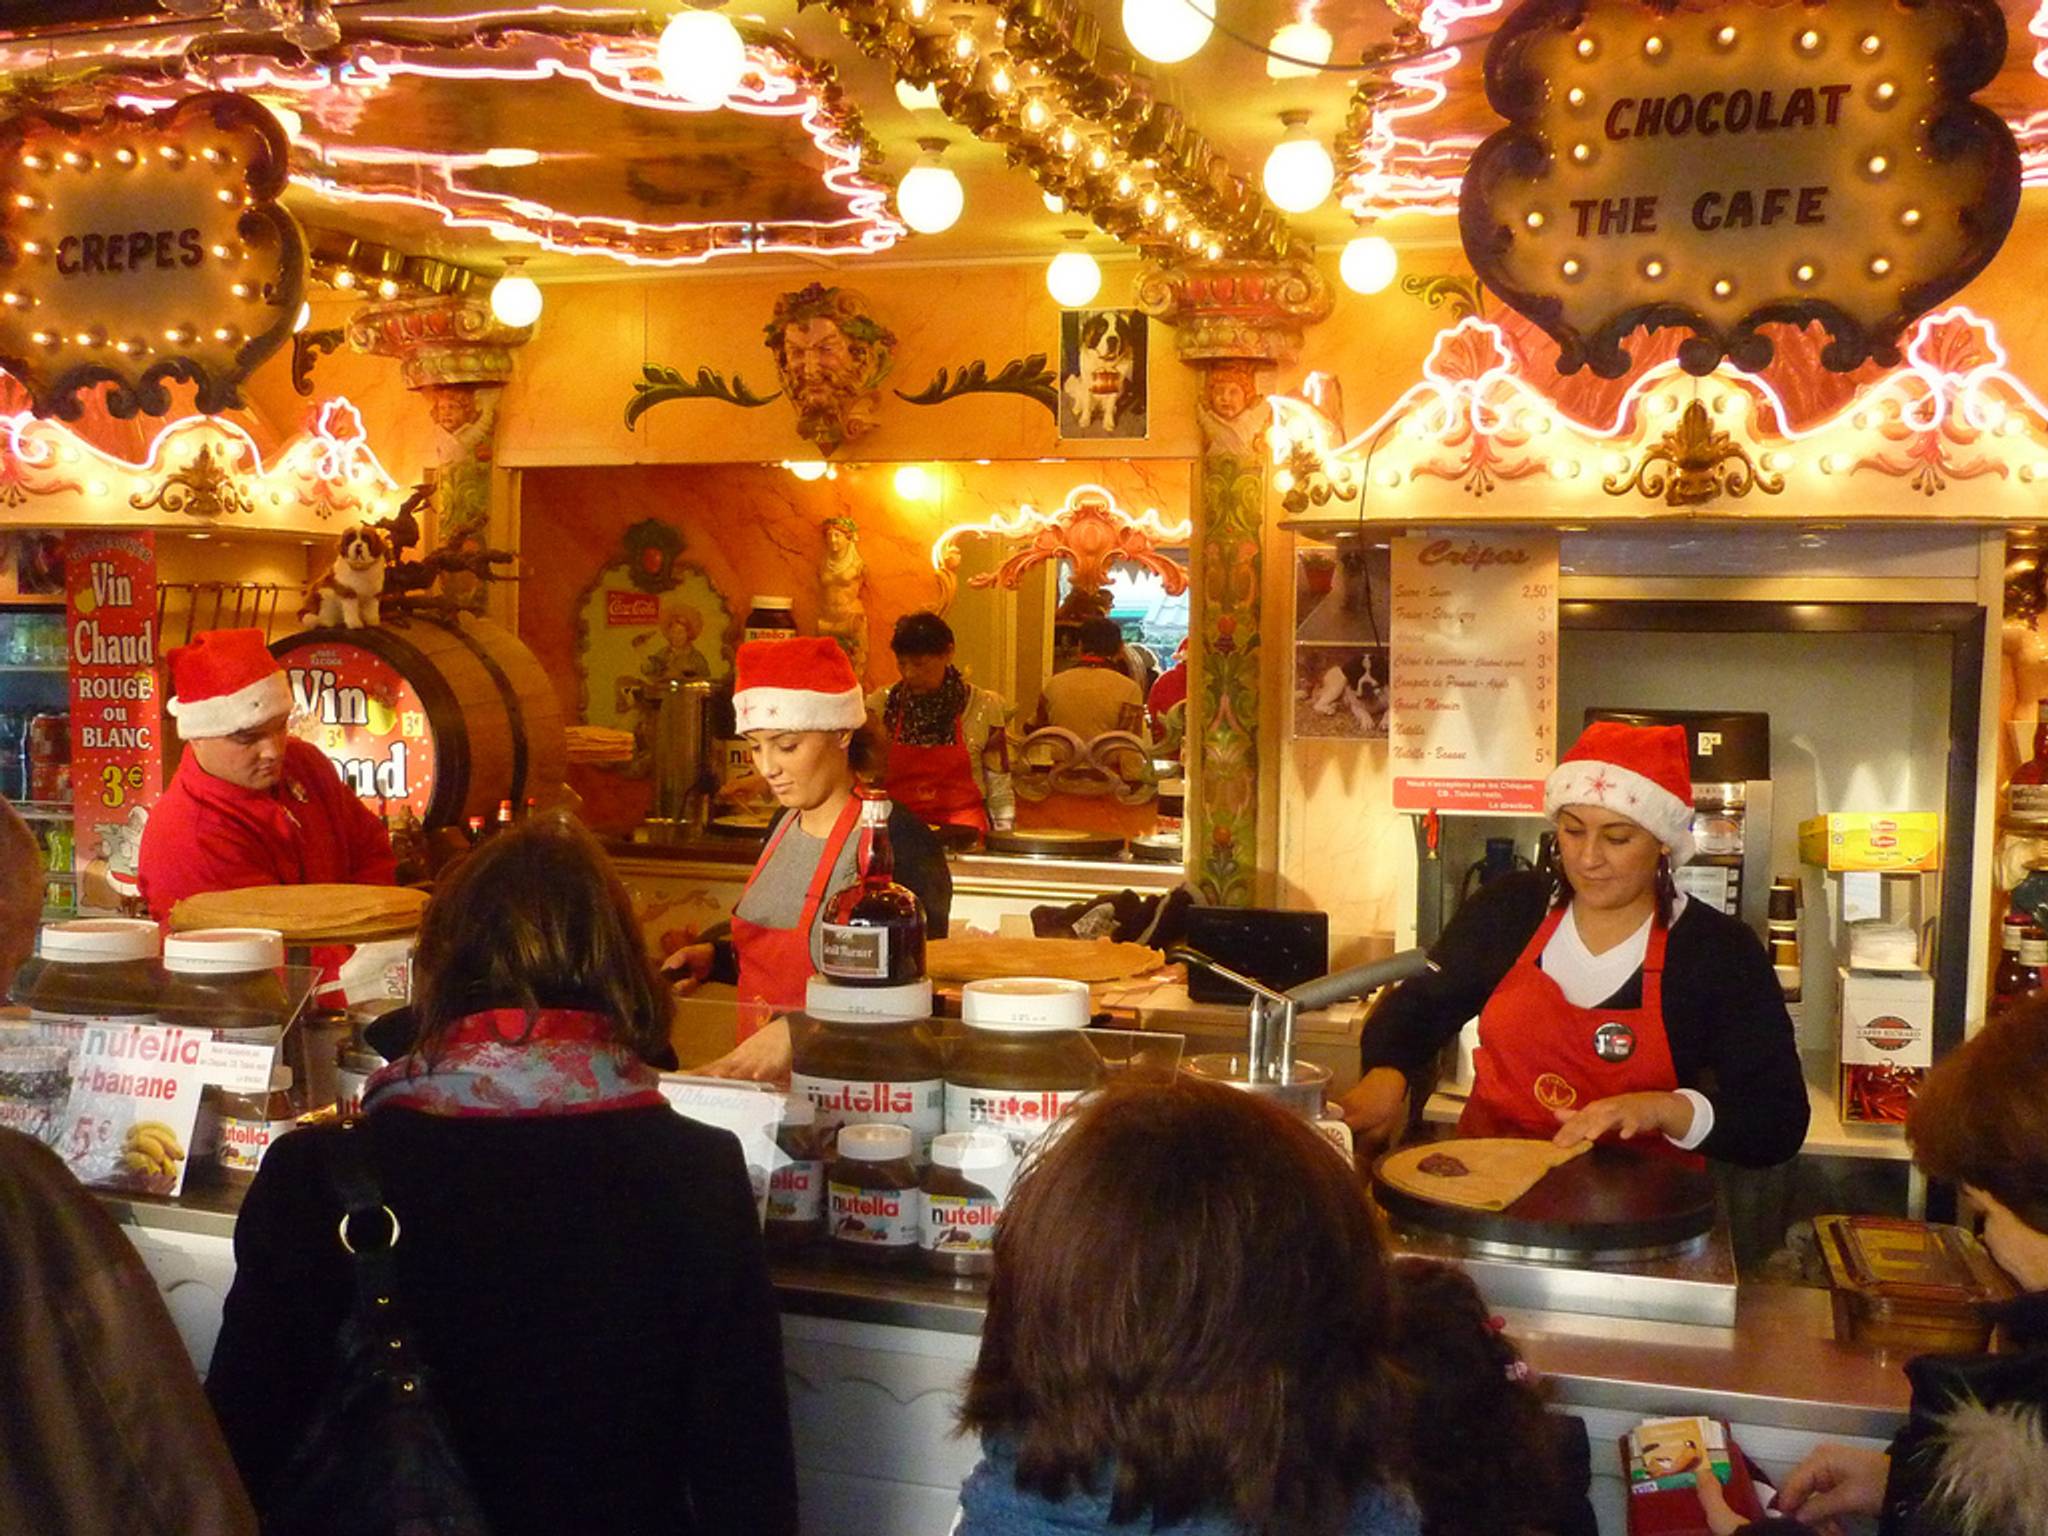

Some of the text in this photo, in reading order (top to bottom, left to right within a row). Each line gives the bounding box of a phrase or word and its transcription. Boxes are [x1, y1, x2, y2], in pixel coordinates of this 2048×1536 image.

[1604, 84, 1853, 141] CHOCOLAT
[1570, 186, 1829, 237] THE CAFE
[56, 228, 204, 275] CREPES
[91, 561, 133, 607] Vin
[73, 619, 154, 666] Chaud
[78, 677, 151, 700] ROUGE
[289, 669, 369, 724] Vin
[102, 705, 128, 722] ou
[82, 727, 151, 748] BLANC
[102, 764, 144, 808] 3€
[84, 1026, 200, 1065] nutella
[808, 1084, 913, 1113] nutella
[223, 1126, 270, 1146] utella
[833, 1196, 899, 1217] nutella
